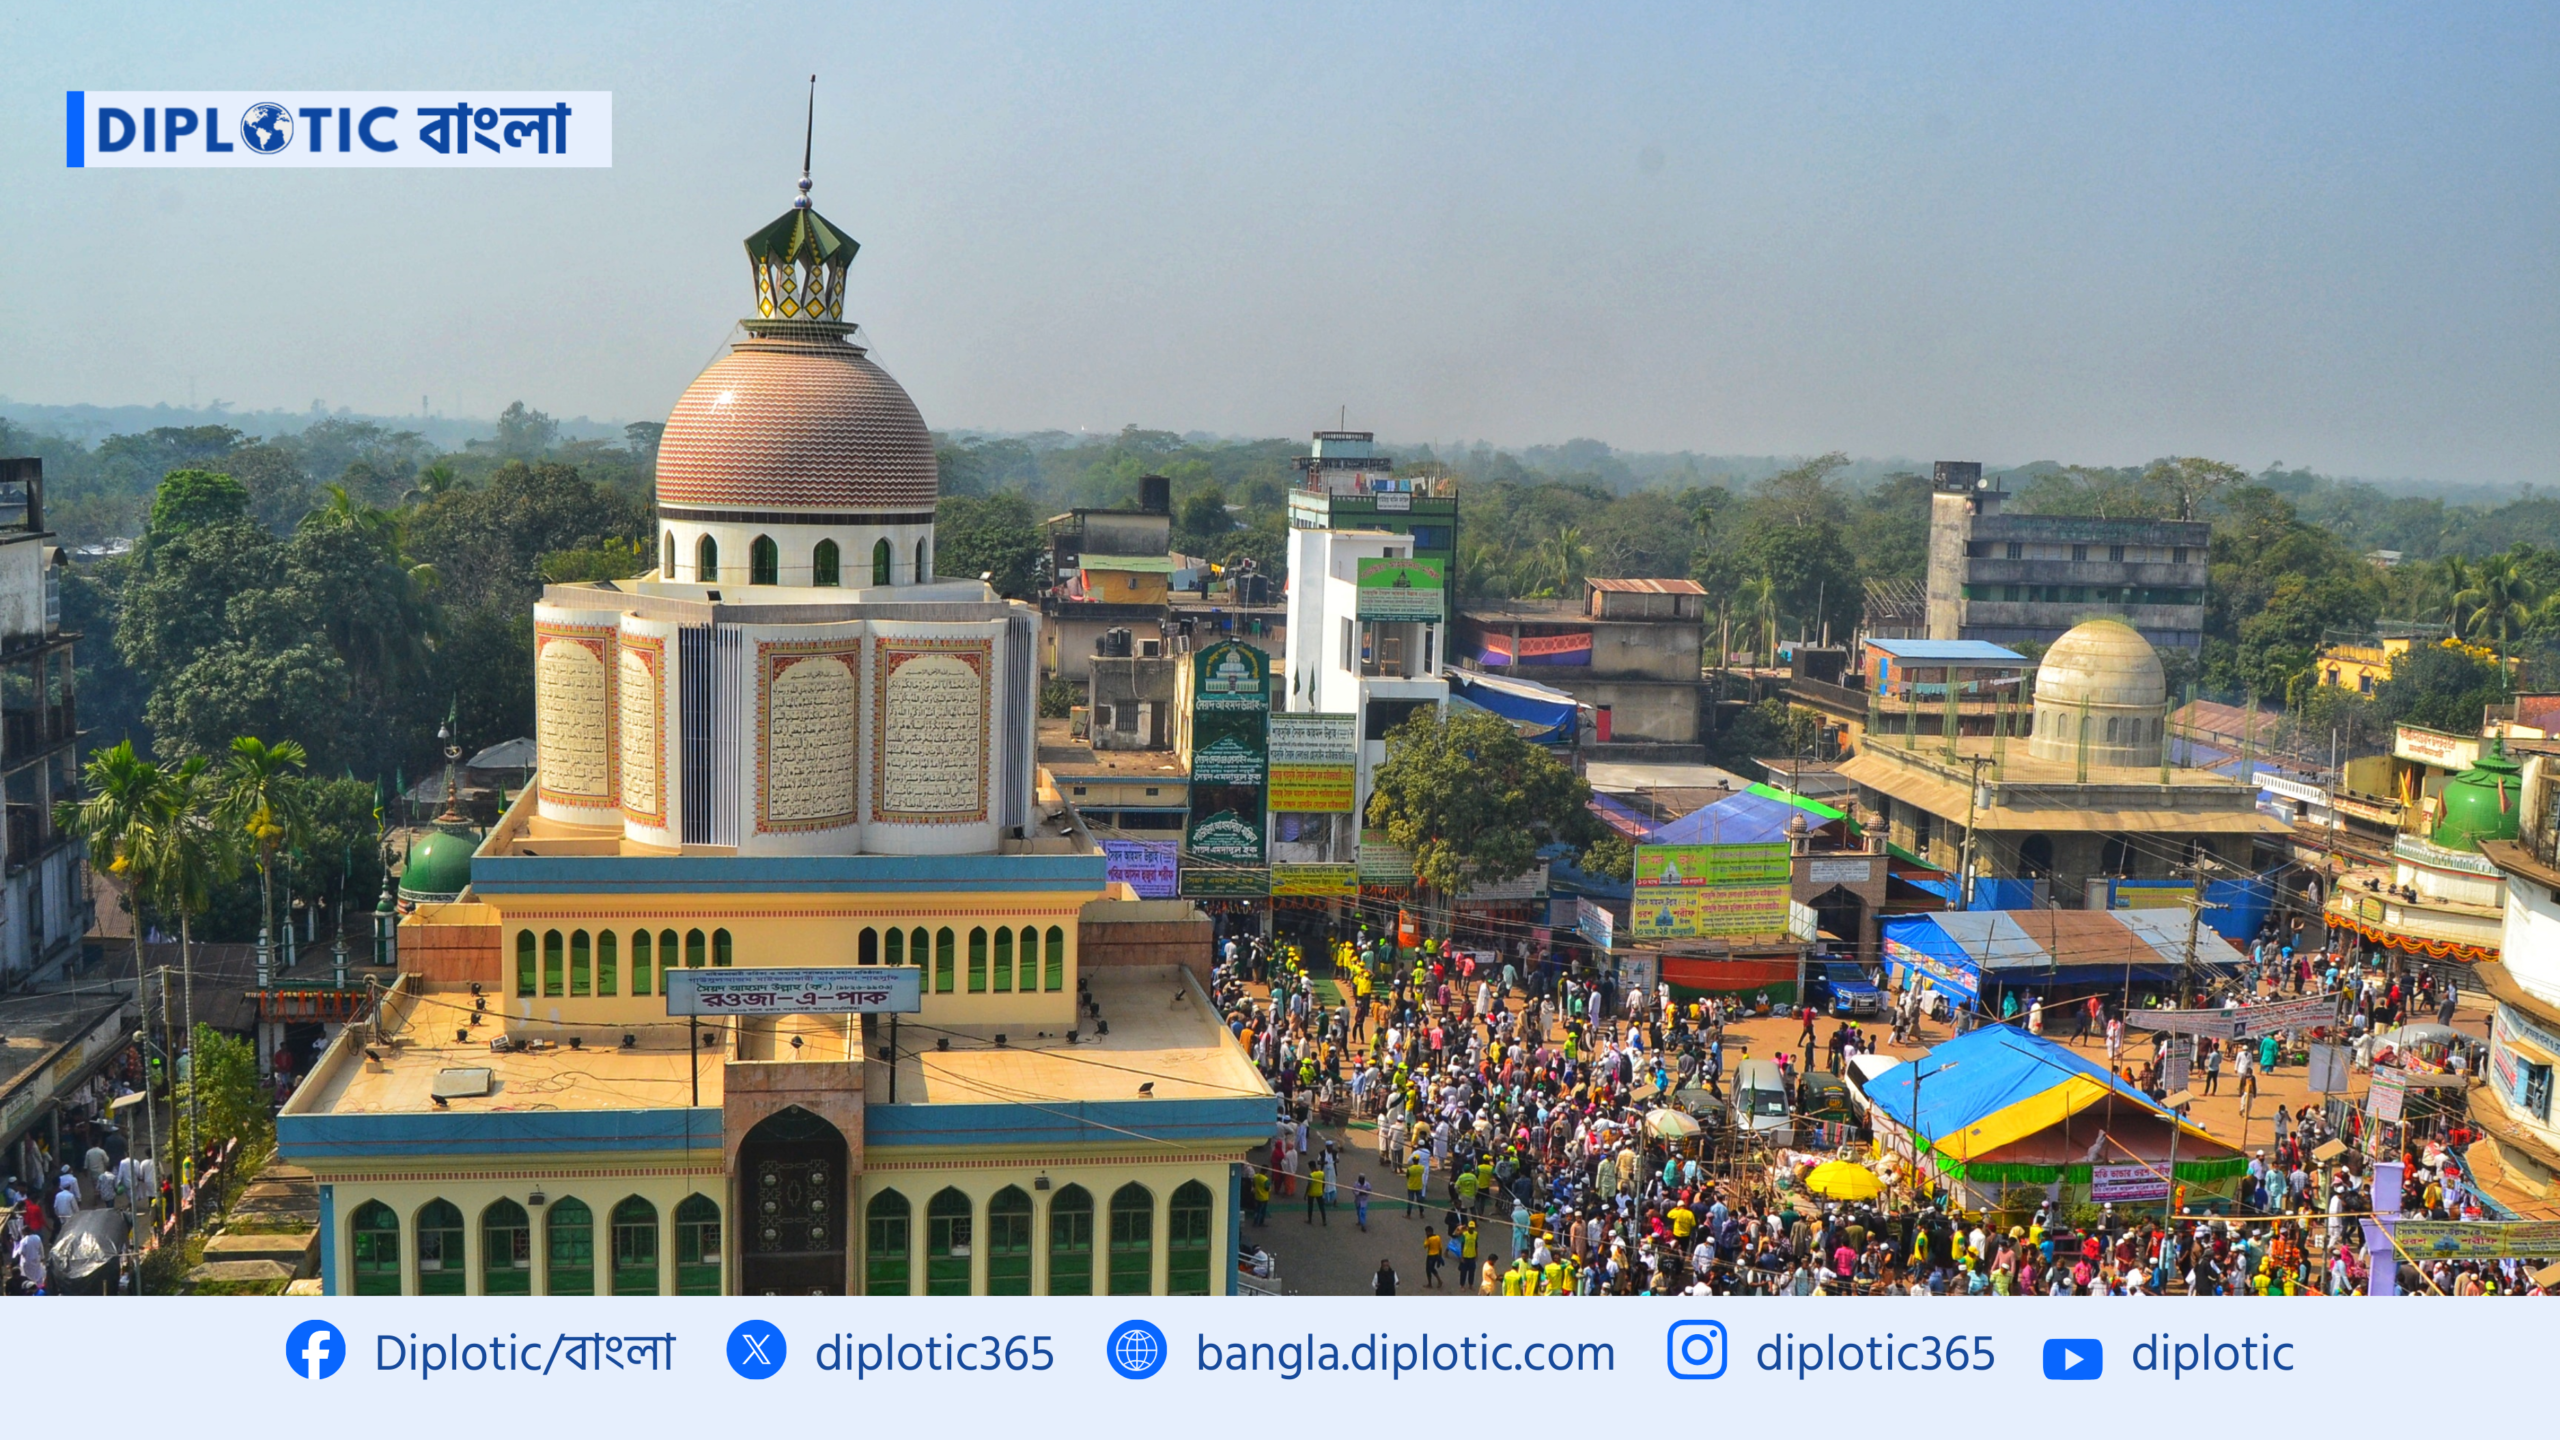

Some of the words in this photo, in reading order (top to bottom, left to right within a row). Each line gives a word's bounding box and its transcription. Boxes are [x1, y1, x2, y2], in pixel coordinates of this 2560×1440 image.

[1673, 907, 1695, 918] শরীফ
[861, 974, 899, 982] শাহসুফি
[697, 982, 726, 993] সৈয়দ
[728, 984, 768, 992] আহমদ
[771, 982, 802, 993] উল্লাহ
[804, 982, 833, 992] (ক.)
[700, 991, 889, 1008] রওজা-এ-পাক
[2461, 1236, 2498, 1245] শরীফ
